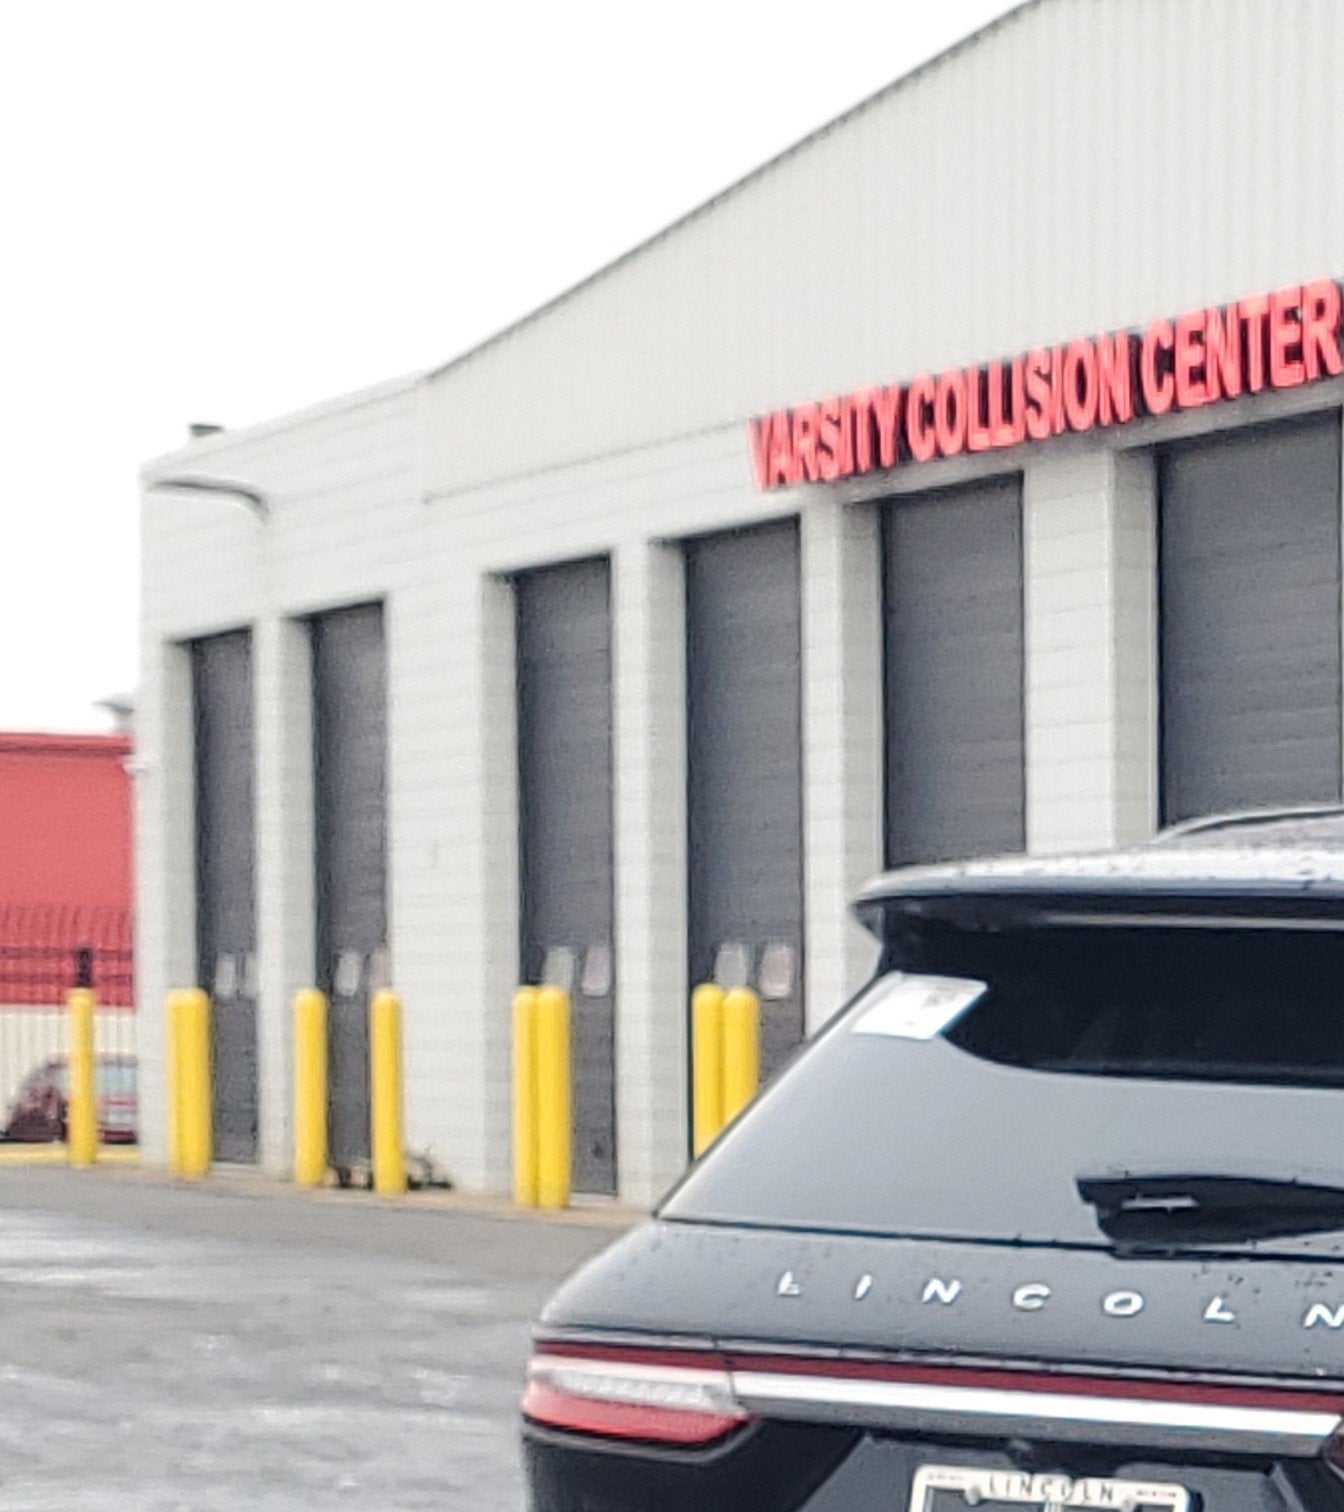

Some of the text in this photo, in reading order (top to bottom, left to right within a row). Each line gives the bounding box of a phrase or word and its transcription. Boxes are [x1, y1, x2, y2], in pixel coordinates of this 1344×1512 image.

[747, 275, 1344, 491] VARSITY COLLISION CENTER
